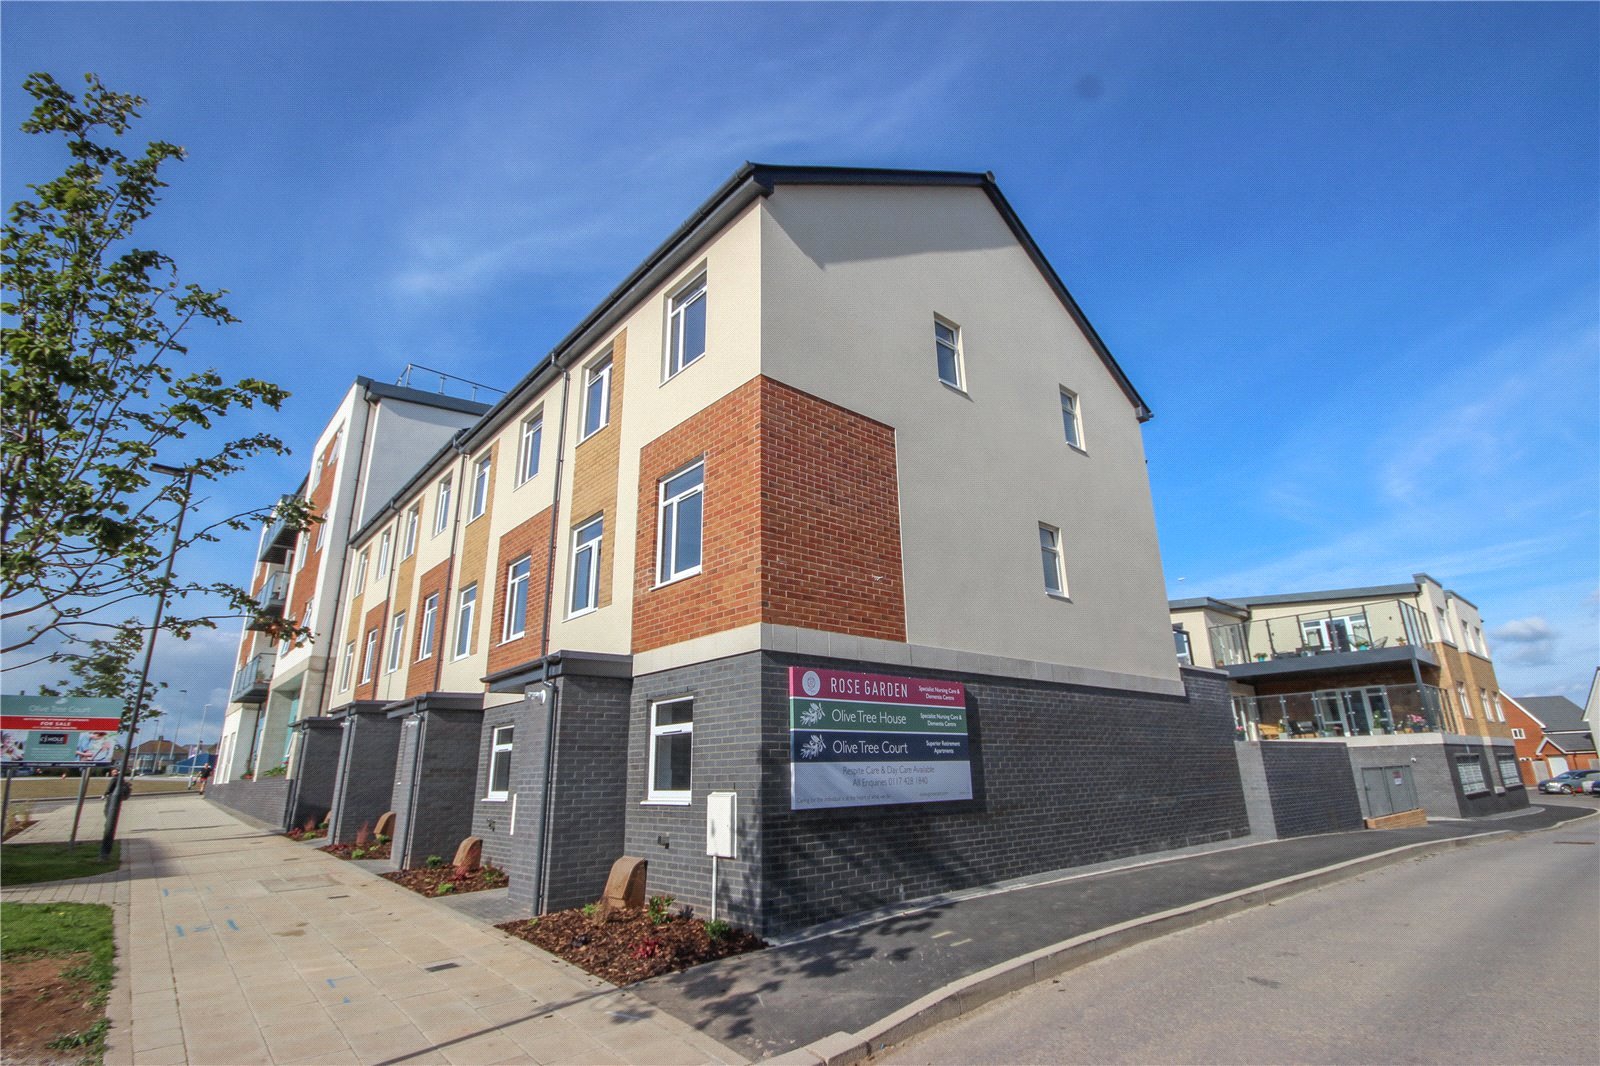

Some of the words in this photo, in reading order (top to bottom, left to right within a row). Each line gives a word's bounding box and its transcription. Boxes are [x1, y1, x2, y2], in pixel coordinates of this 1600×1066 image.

[830, 677, 860, 694] ROSE
[864, 681, 908, 698] GARDEN
[832, 709, 856, 722] Olive
[857, 710, 877, 723] Tree
[879, 711, 907, 724] House
[832, 740, 858, 753] Olive
[858, 740, 879, 754] Tree
[881, 740, 909, 754] Court
[842, 766, 864, 776] Respite
[866, 766, 880, 774] Care
[880, 766, 886, 774] &
[887, 766, 898, 775] Day
[899, 765, 912, 774] Care
[913, 765, 935, 774] Available
[852, 778, 861, 786] All
[862, 778, 887, 787] Enquiries
[888, 777, 902, 785] 0117
